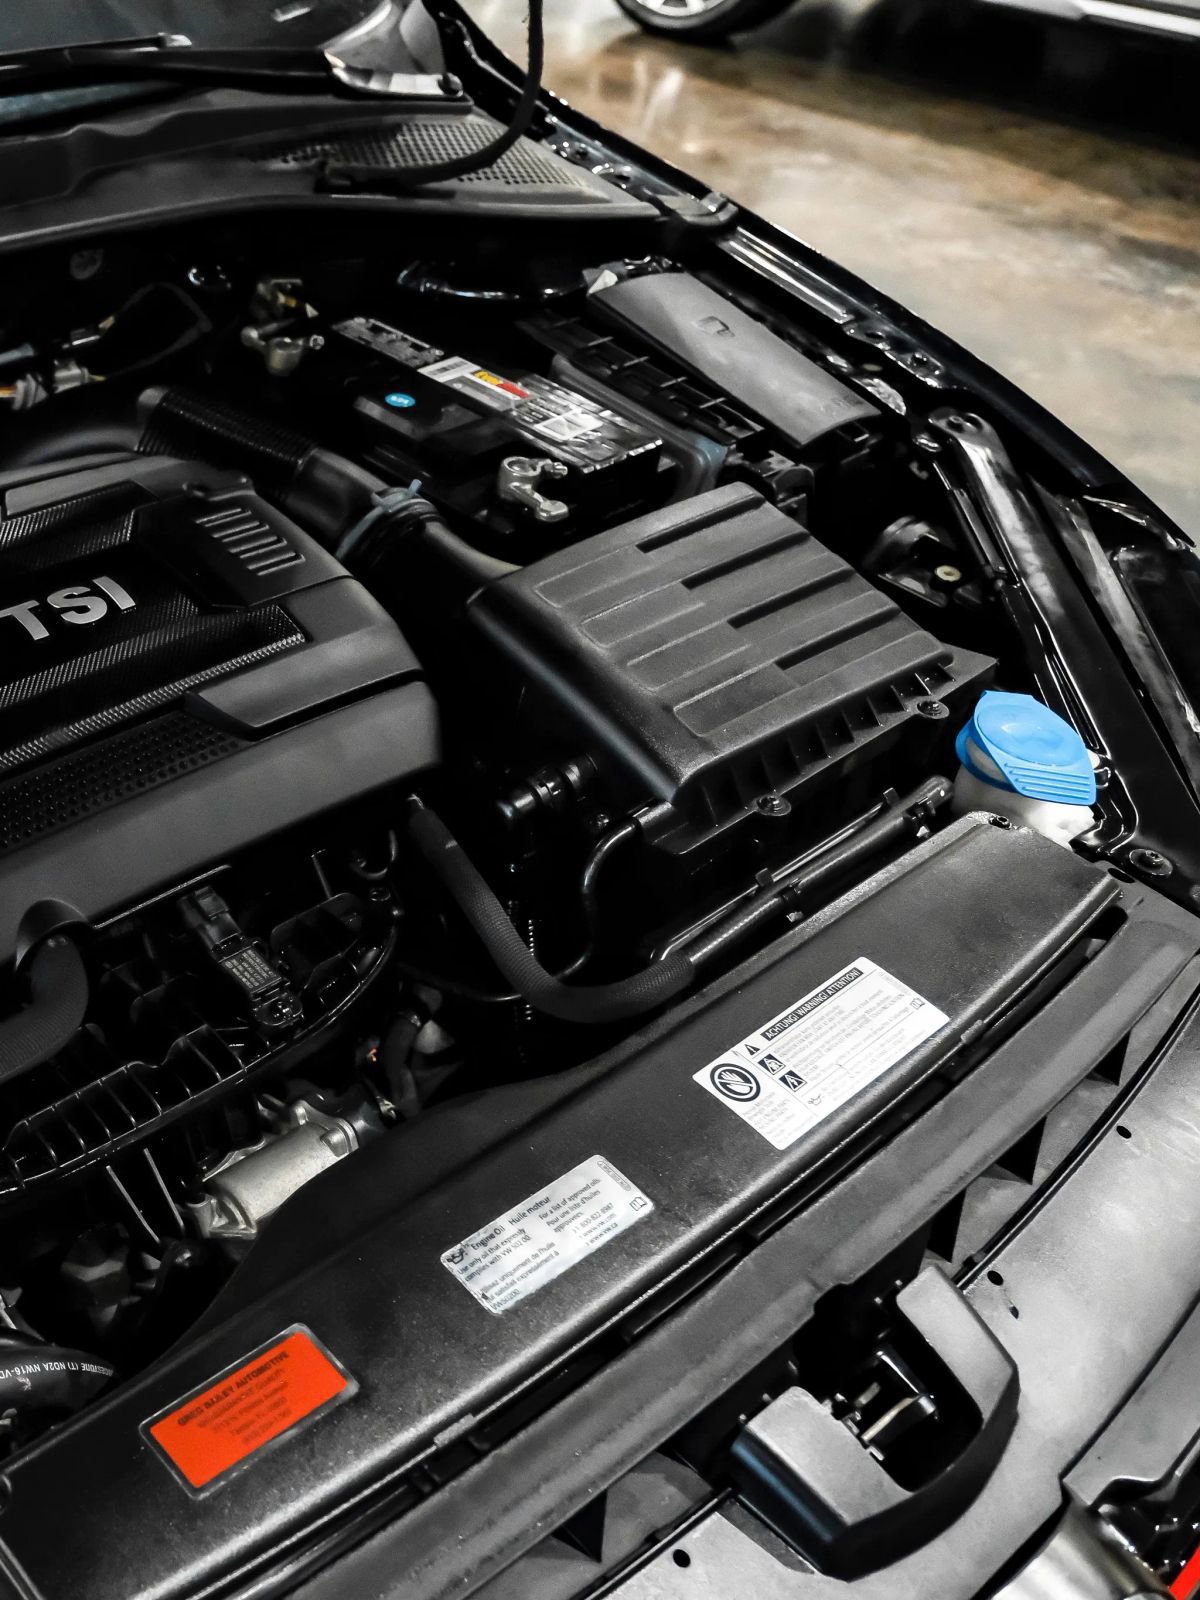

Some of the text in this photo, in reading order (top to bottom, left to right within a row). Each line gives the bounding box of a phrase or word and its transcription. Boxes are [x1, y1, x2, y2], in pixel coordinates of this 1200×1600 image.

[765, 1013, 799, 1038] ACHTUNG!
[795, 991, 829, 1015] WARNING!
[826, 969, 860, 995] ATTENTION!
[538, 1211, 549, 1220] For
[550, 1203, 562, 1211] list
[560, 1198, 568, 1206] of
[567, 1183, 591, 1202] approved
[470, 1196, 550, 1250] Engine Oil Huile moteur
[456, 1265, 469, 1275] Use
[468, 1257, 482, 1268] only
[481, 1250, 490, 1259] oil
[487, 1243, 501, 1254] that
[488, 1254, 502, 1265] with
